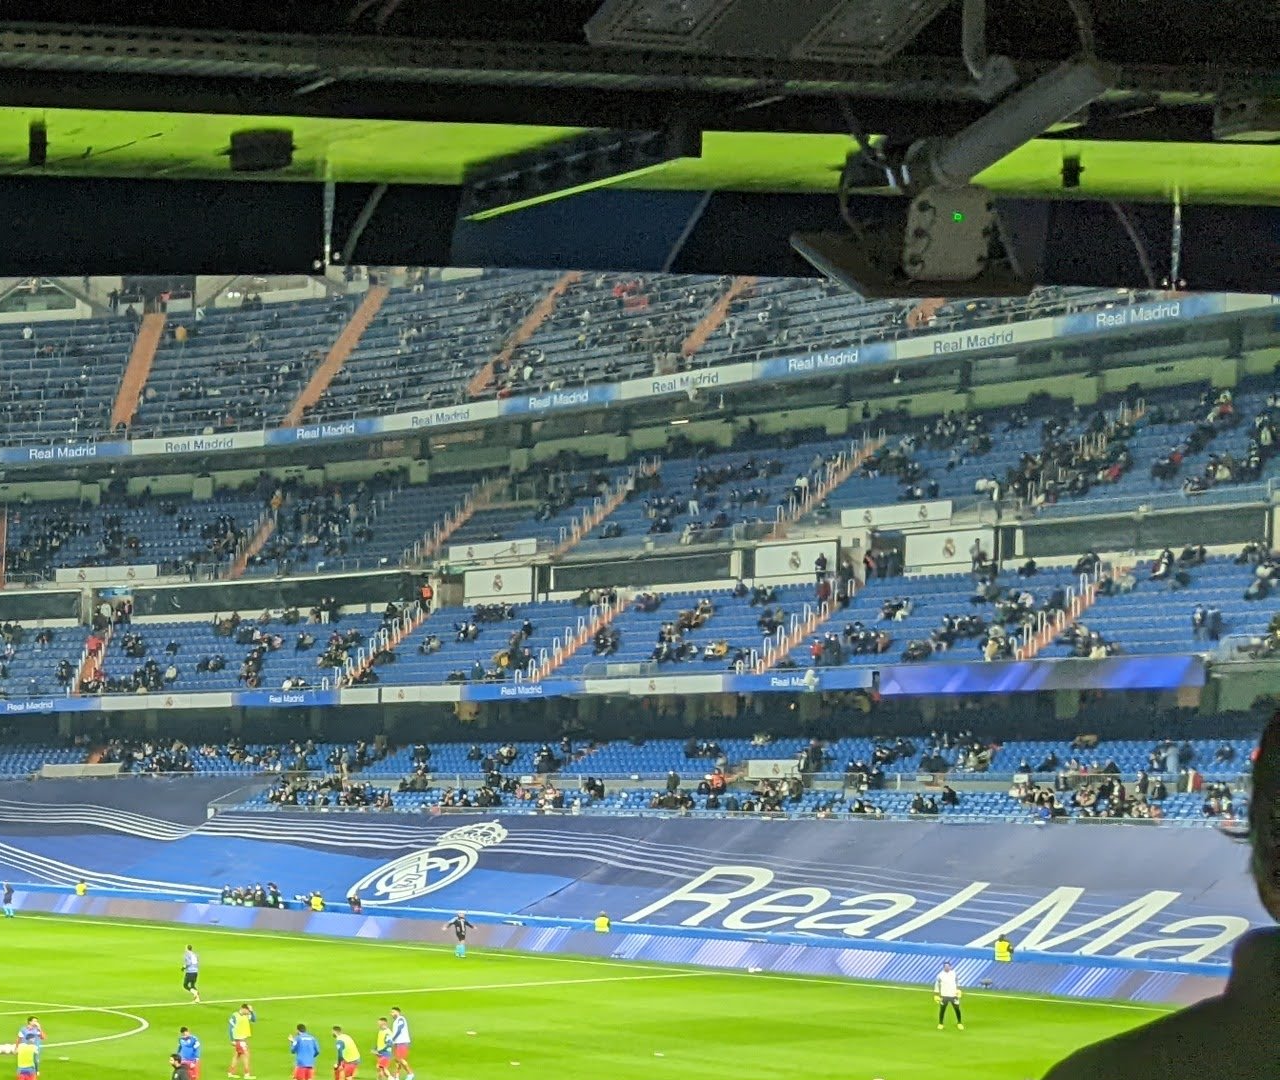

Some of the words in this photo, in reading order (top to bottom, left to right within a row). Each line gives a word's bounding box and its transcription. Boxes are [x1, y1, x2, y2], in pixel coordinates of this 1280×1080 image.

[1096, 312, 1128, 329] Real
[1131, 303, 1180, 325] Madrid
[934, 338, 963, 354] Real
[966, 330, 1014, 349] Madrid
[788, 358, 815, 372] Real
[817, 350, 859, 368] Madrid
[652, 378, 680, 393] Real
[682, 372, 720, 389] Mdrid
[529, 395, 551, 409] Real
[411, 414, 433, 427] Real
[435, 409, 470, 425] Madrid
[296, 427, 319, 441] Real
[321, 422, 355, 438] Madrid
[29, 447, 53, 460] Real
[56, 443, 97, 458] Madrid
[165, 440, 190, 453] Real
[192, 437, 234, 452] Madrid
[621, 865, 990, 941] Real
[974, 886, 1251, 964] Ma
